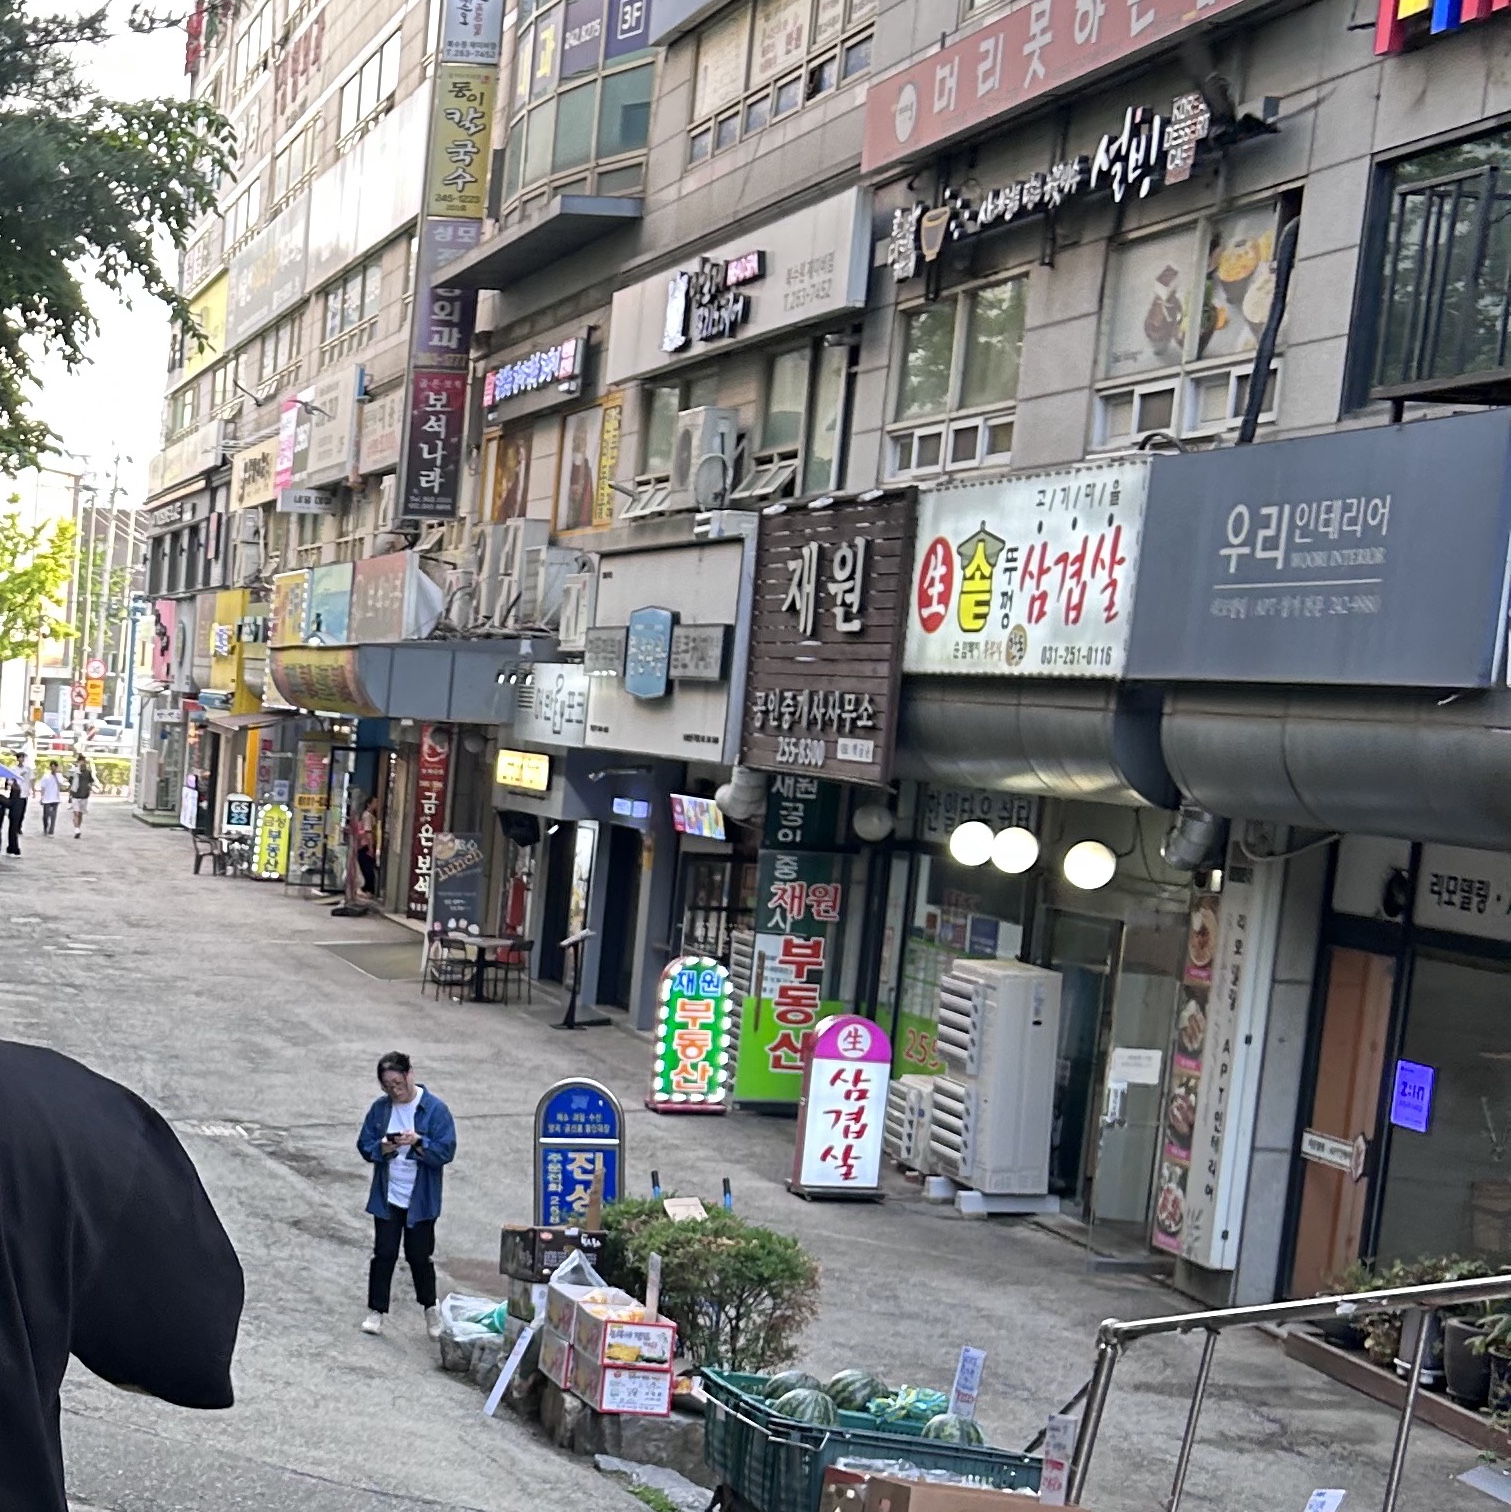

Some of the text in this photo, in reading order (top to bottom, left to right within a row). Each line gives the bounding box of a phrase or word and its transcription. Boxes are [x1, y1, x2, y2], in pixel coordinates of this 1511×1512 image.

[621, 2, 642, 30] 3F
[448, 81, 485, 106] 동이
[443, 107, 486, 192] 칼국수
[1090, 105, 1162, 203] 설빙
[433, 225, 477, 244] 성모
[419, 391, 456, 495] 보석나라
[1218, 494, 1392, 574] 우리 인테리어
[782, 536, 868, 637] 재원
[922, 543, 948, 617] 生
[1018, 524, 1126, 626] 삼겹살
[1040, 646, 1113, 666] 031-251-0116
[752, 688, 875, 734] 공인중개사사무소
[776, 735, 827, 769] 255-8300
[231, 802, 249, 813] GS
[263, 830, 281, 870] 부동산
[768, 881, 841, 920] 재원
[1430, 871, 1490, 914] 리모델링
[673, 970, 723, 997] 재원
[768, 938, 825, 1074] 부동산
[670, 999, 716, 1092] 부동산
[842, 1026, 866, 1053] 生
[819, 1067, 872, 1182] 삼겹살
